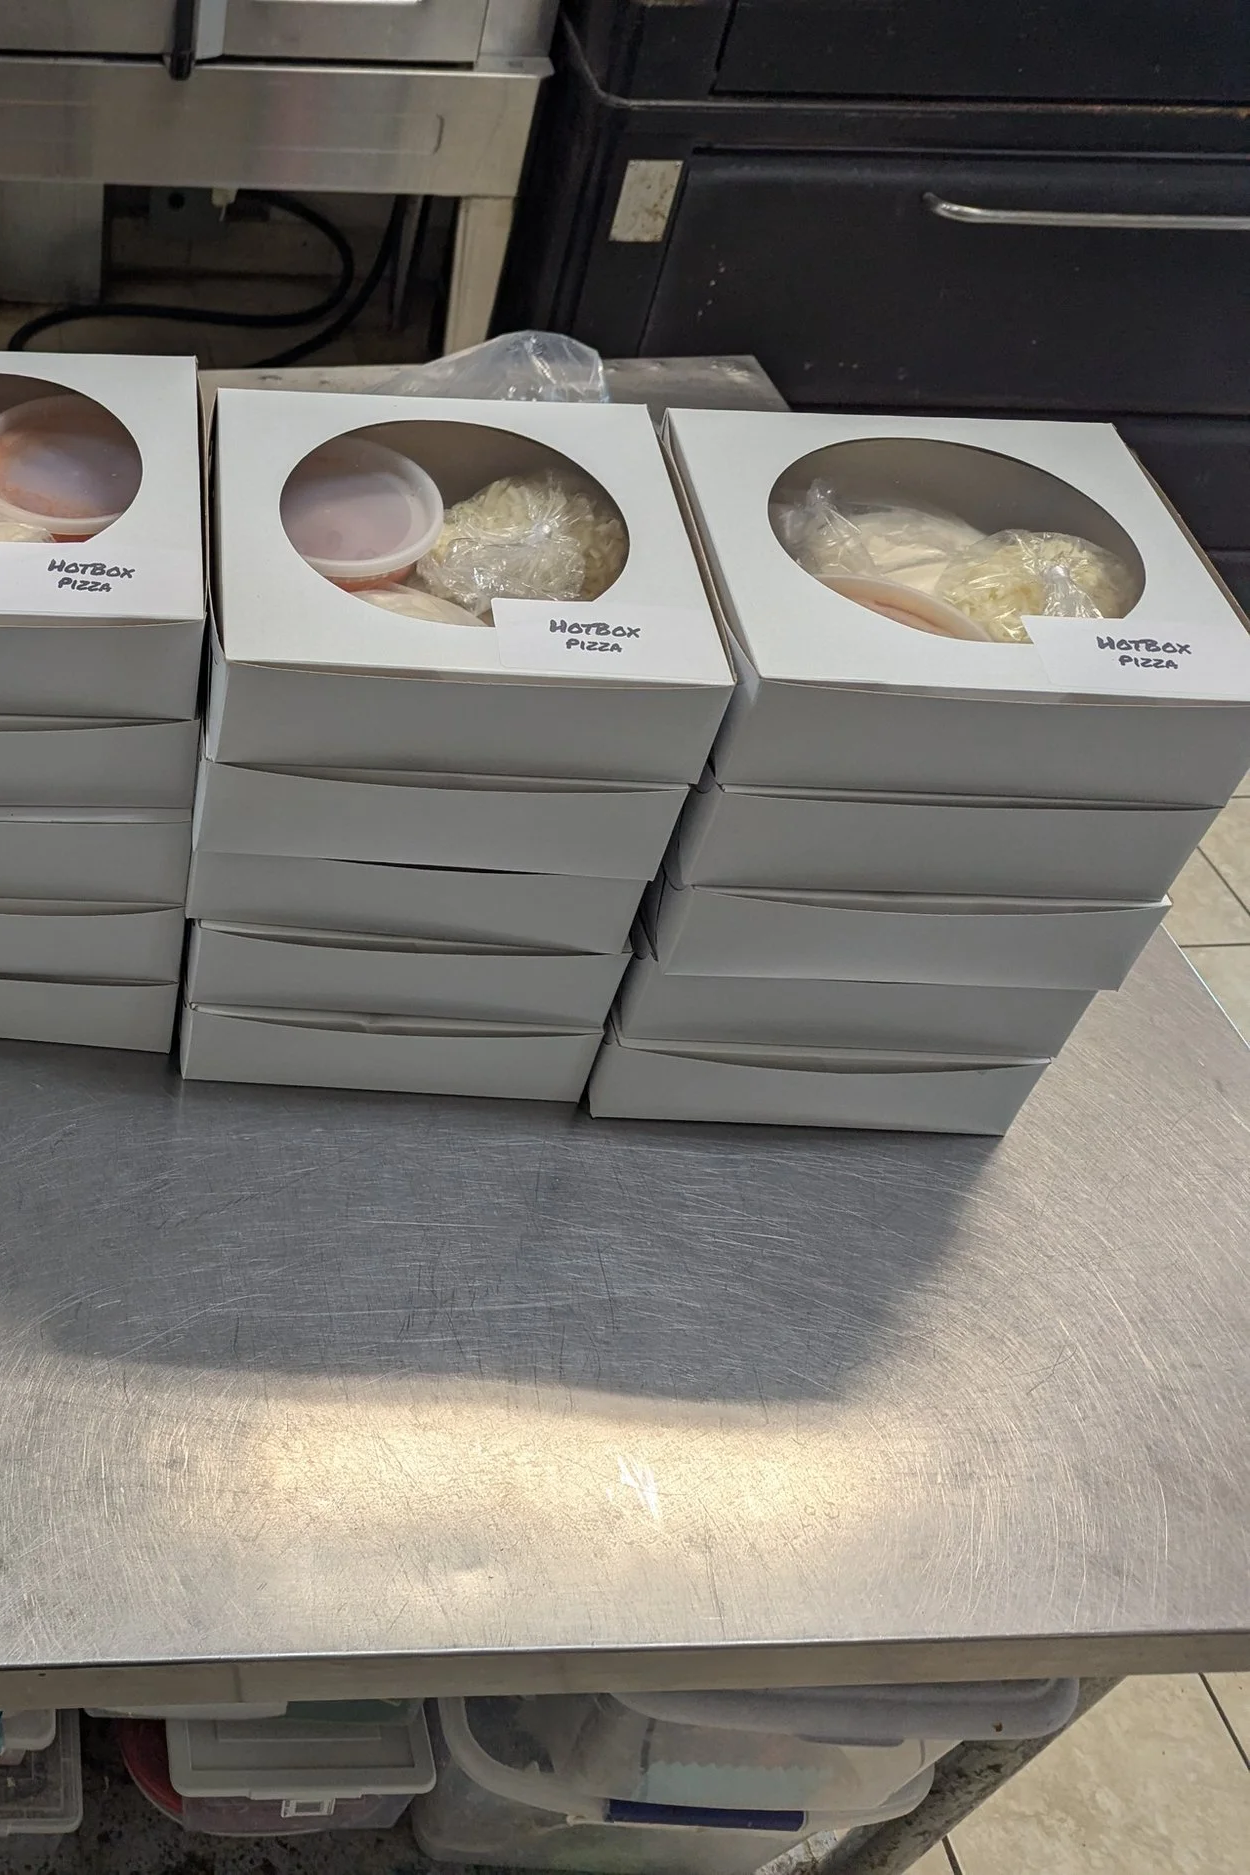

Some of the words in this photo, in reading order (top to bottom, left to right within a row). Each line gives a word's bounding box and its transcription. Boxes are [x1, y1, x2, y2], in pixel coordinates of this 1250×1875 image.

[57, 576, 113, 593] PIZZA
[565, 637, 623, 653] PIZZA
[1118, 654, 1179, 670] PIZZA
